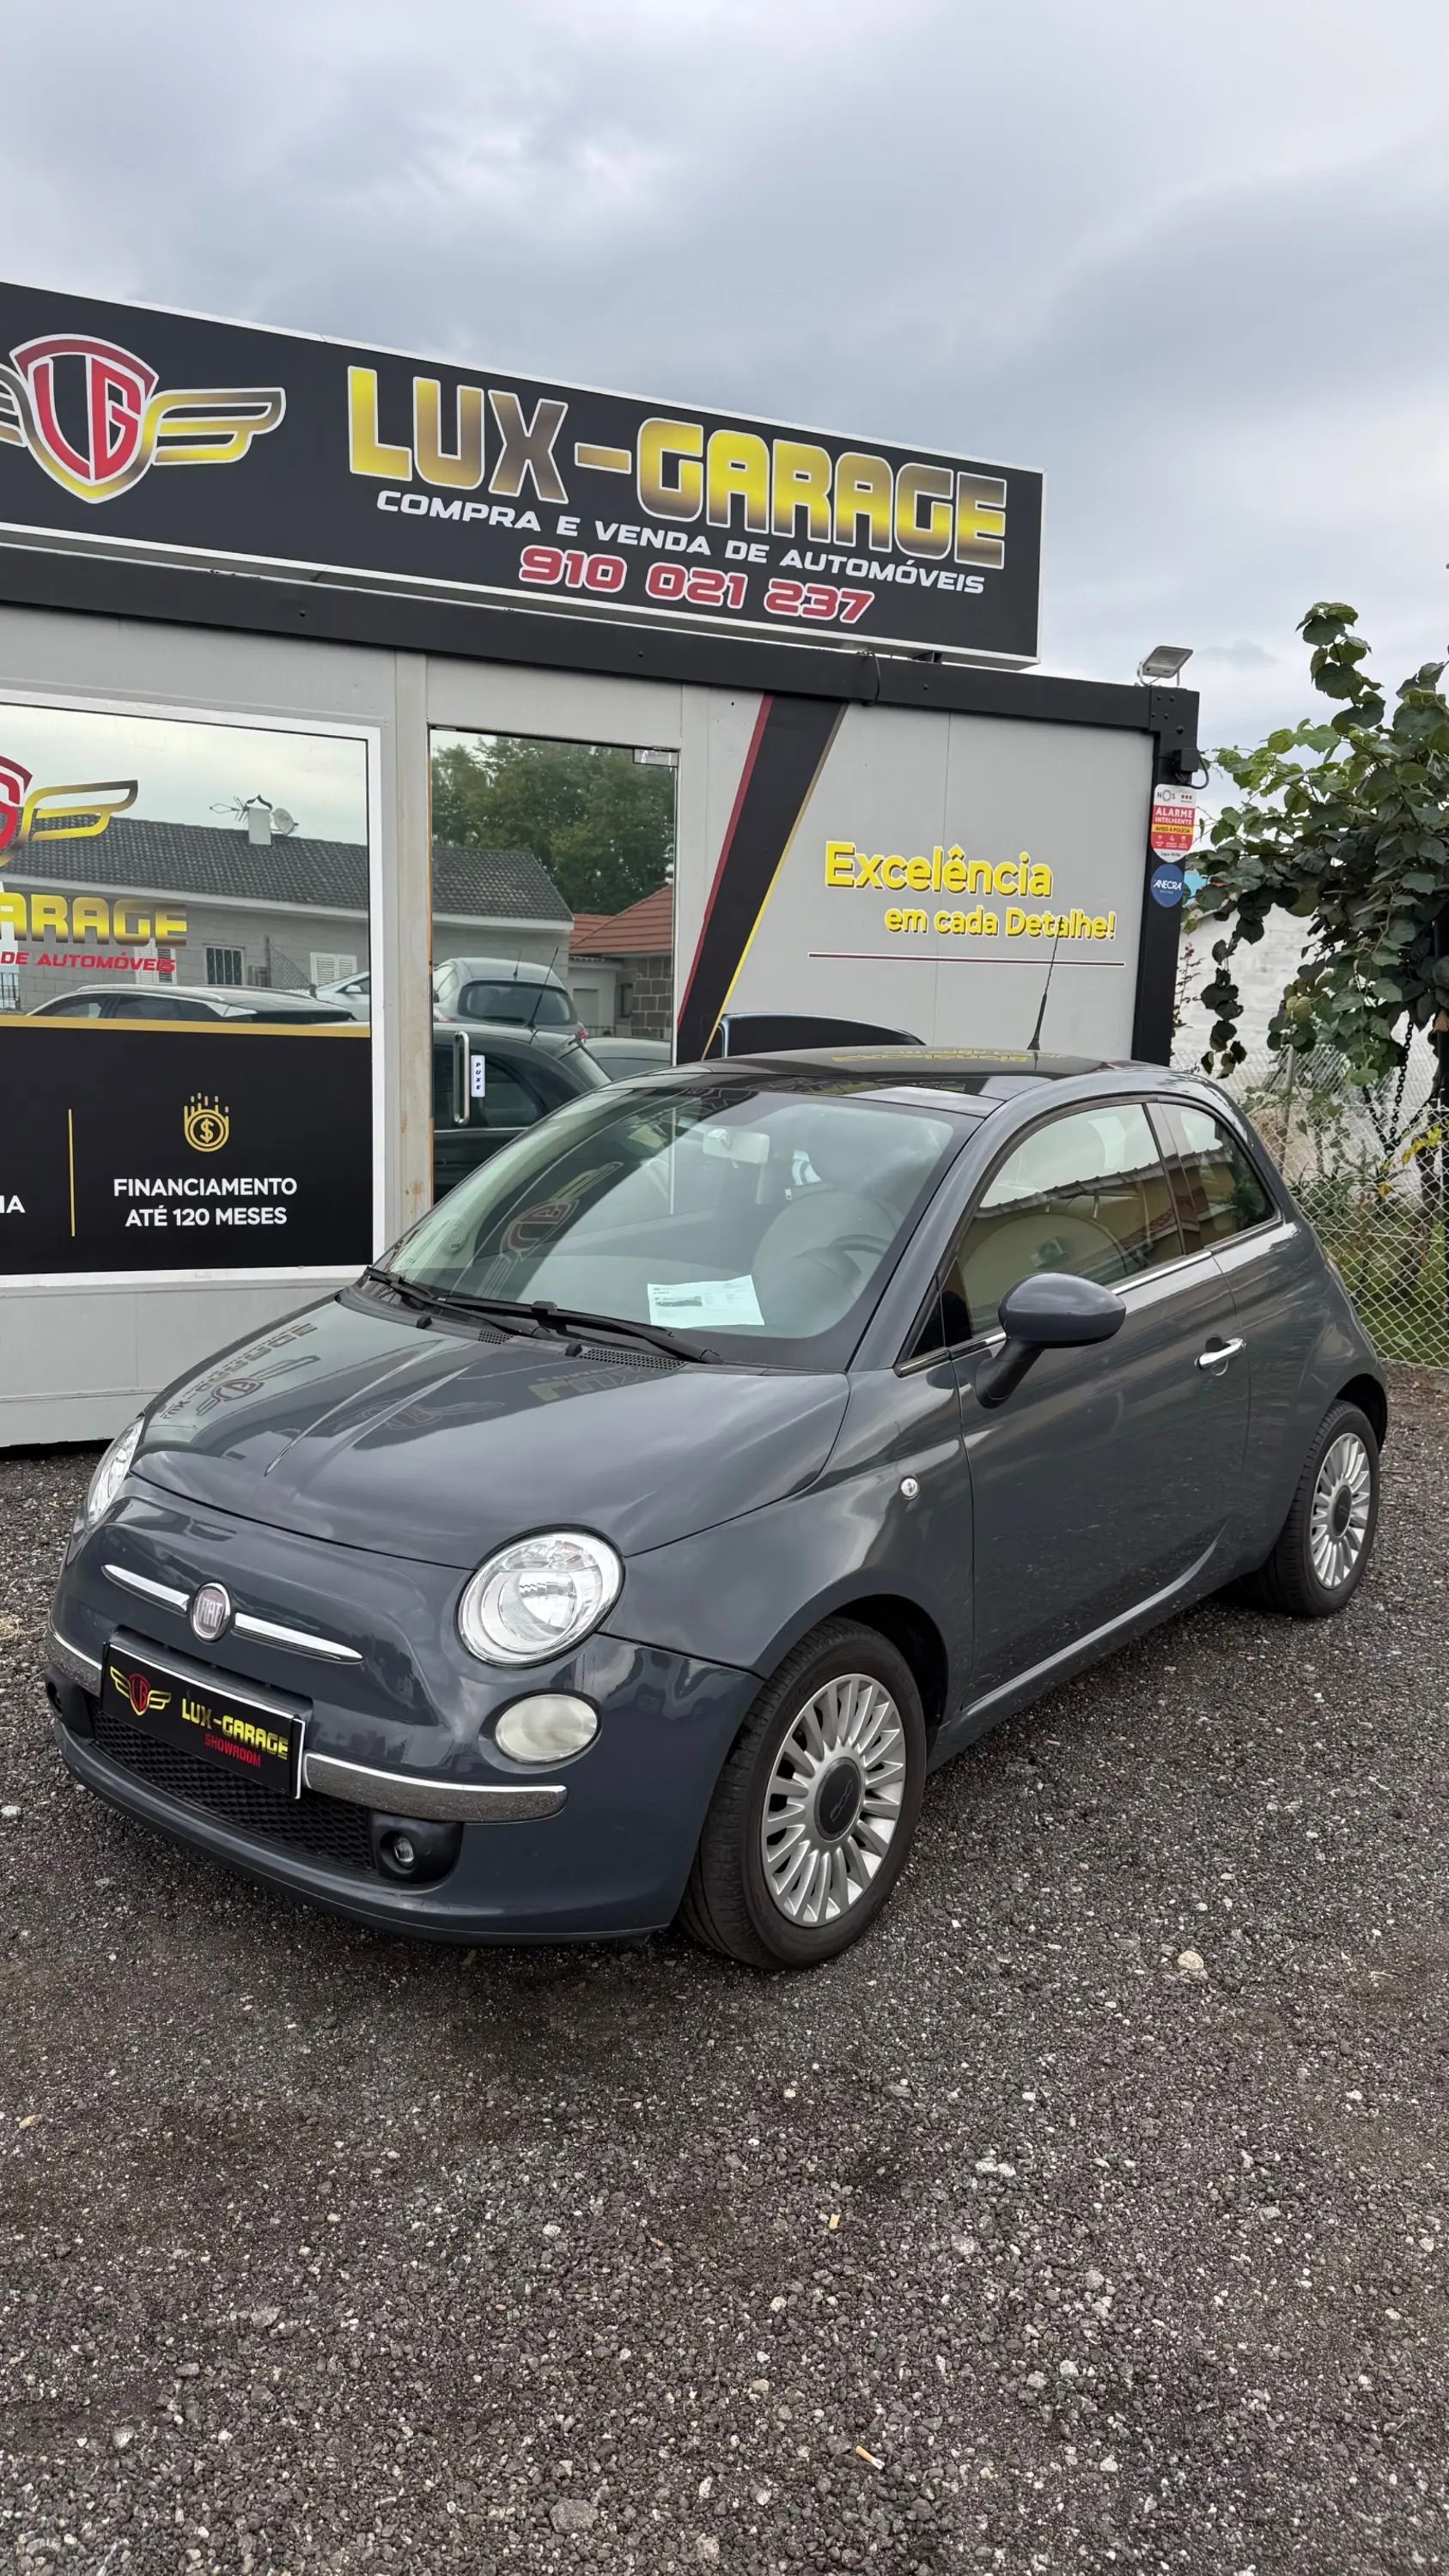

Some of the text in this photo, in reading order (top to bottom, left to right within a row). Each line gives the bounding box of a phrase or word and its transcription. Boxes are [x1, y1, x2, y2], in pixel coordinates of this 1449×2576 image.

[347, 365, 1007, 569] LUX-GARAGE
[376, 489, 985, 593] COMPRA E VENDA DE AUTOMÓVEIS
[519, 544, 875, 623] 910 021 237
[1155, 806, 1193, 819] ALARME
[1156, 789, 1176, 802] NOS
[1154, 817, 1192, 825] INTELIGENTE
[825, 840, 1052, 898] Excelência
[884, 906, 1117, 940] em cada Detalhe!
[0, 951, 176, 973] DE AUTOMÓVEIS
[113, 1177, 298, 1197] FINANCIAMENTO
[125, 1205, 287, 1227] ATÉ 120 MESES
[182, 1698, 289, 1760] LUX-GARAGE
[204, 1733, 261, 1768] SHOWROOM
